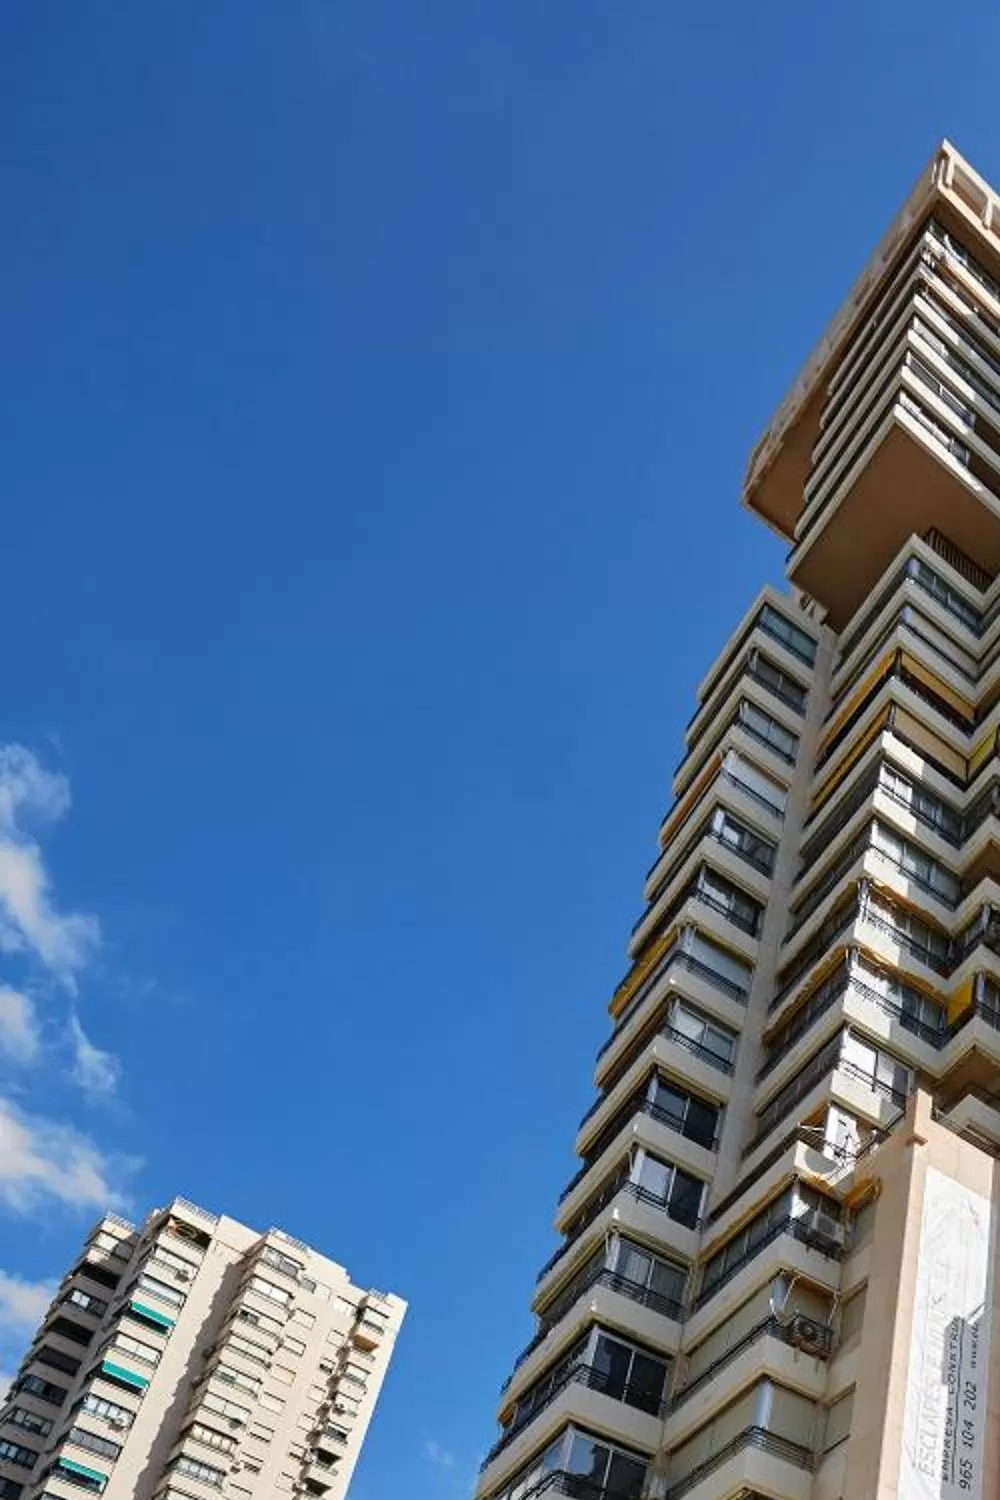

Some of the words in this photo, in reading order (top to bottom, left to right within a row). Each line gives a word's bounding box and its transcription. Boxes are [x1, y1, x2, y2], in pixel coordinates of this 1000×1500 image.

[963, 1380, 977, 1412] 202
[961, 1419, 975, 1450] 104
[958, 1458, 973, 1491] 965
